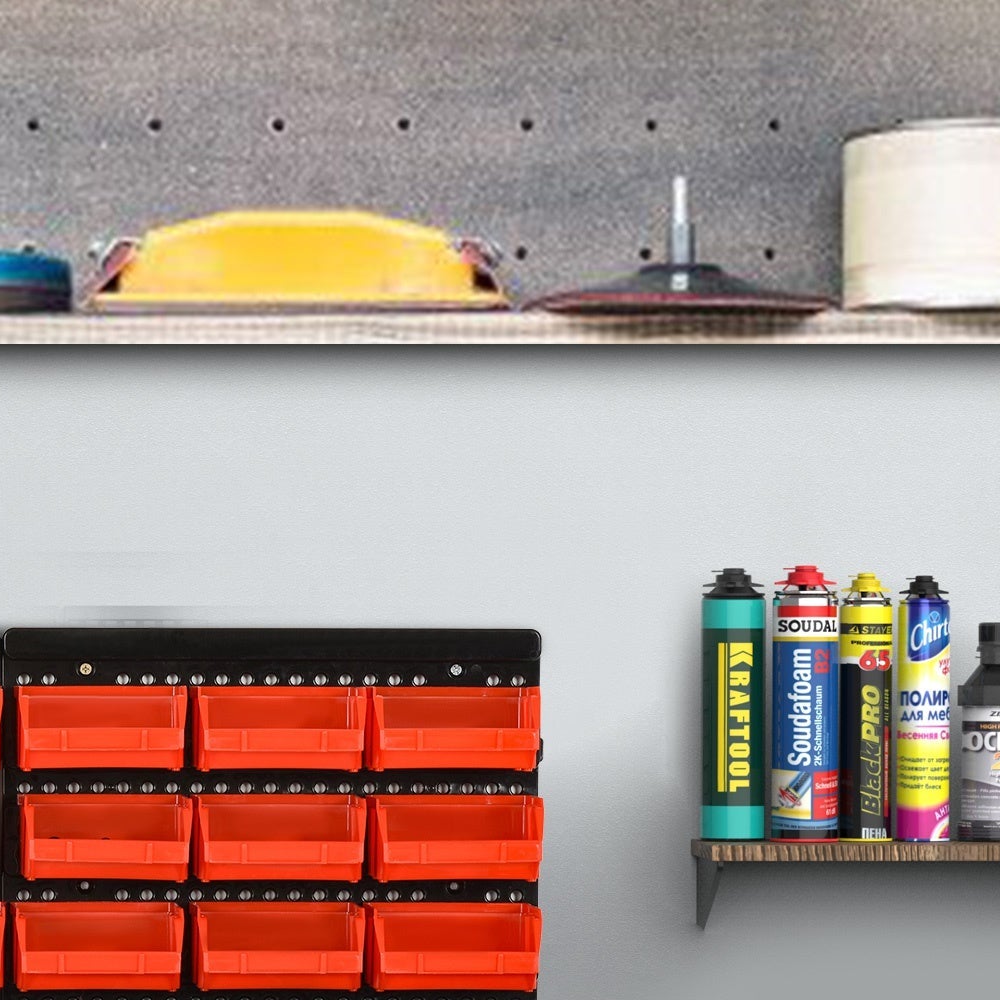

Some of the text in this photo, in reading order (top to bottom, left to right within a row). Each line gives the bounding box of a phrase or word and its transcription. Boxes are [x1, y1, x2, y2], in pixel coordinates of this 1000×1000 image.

[778, 619, 837, 632] SOUDAL
[814, 649, 830, 674] B2
[859, 650, 891, 671] 65
[787, 648, 812, 767] Soudafoam
[900, 690, 950, 706] ПОЛИР
[729, 642, 753, 792] KRAFTOOL
[814, 685, 823, 766] 2K-Schnellschaum
[862, 828, 887, 839] ПЕНА
